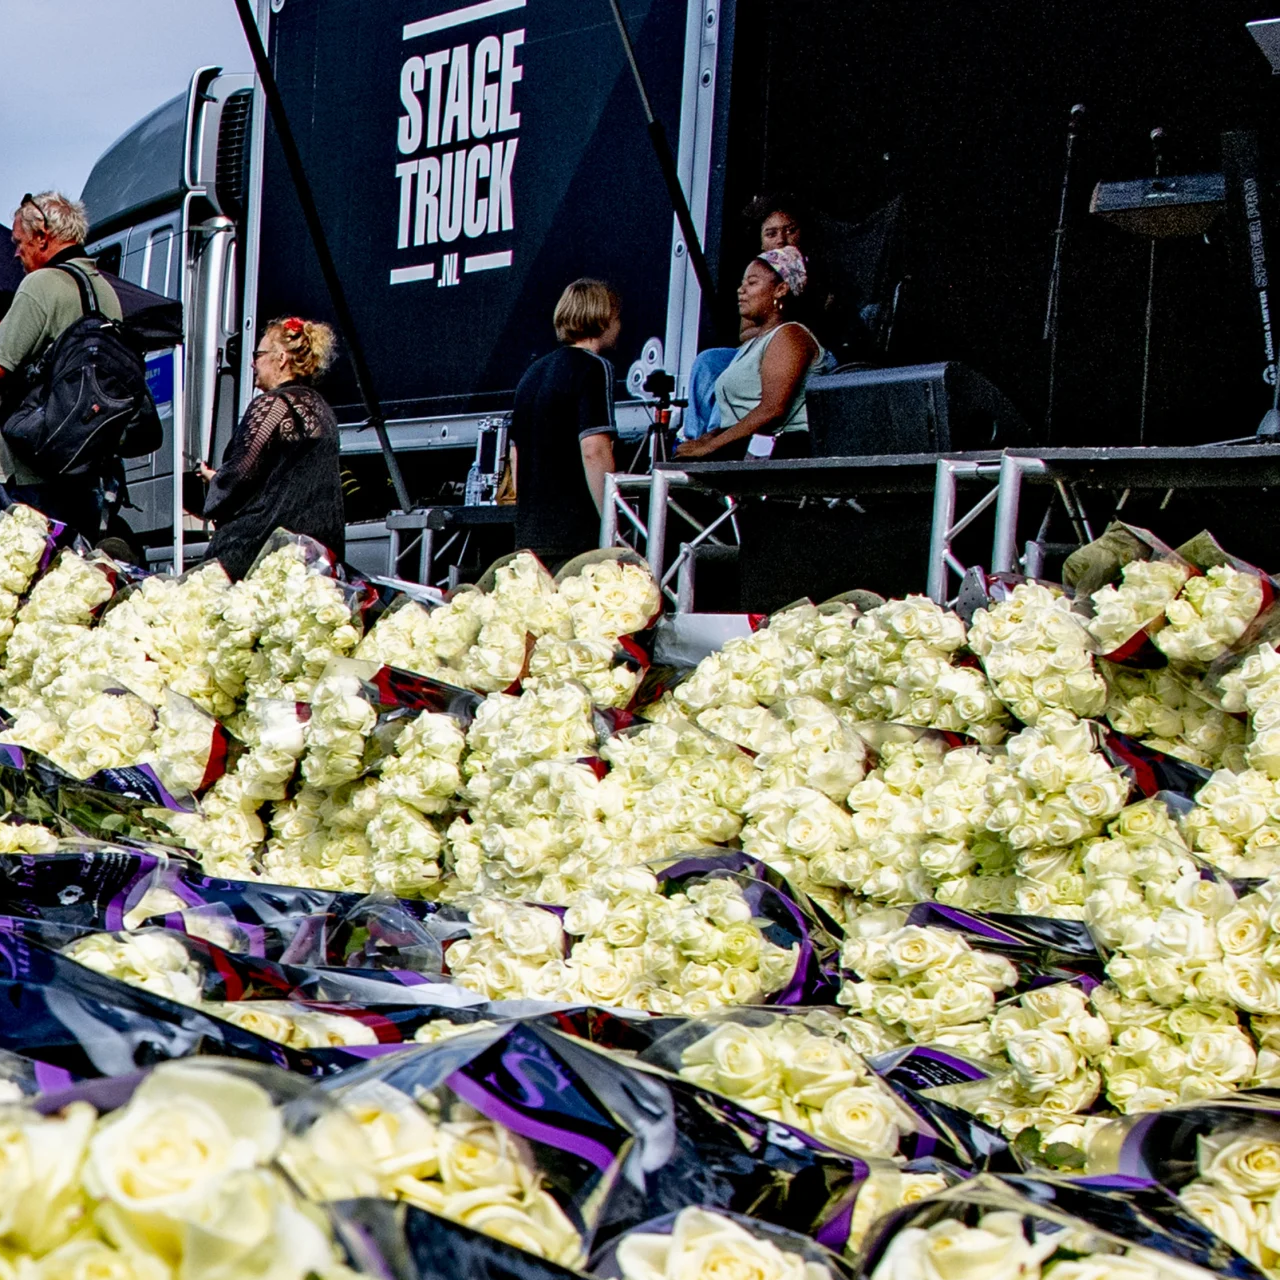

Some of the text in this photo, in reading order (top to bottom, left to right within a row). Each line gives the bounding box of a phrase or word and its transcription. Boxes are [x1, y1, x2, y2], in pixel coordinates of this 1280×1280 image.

[397, 28, 526, 155] STAGE
[396, 138, 519, 250] TRUCK
[437, 253, 460, 287] .NL
[1249, 220, 1268, 288] SPIDER
[1259, 291, 1270, 323] MEYER
